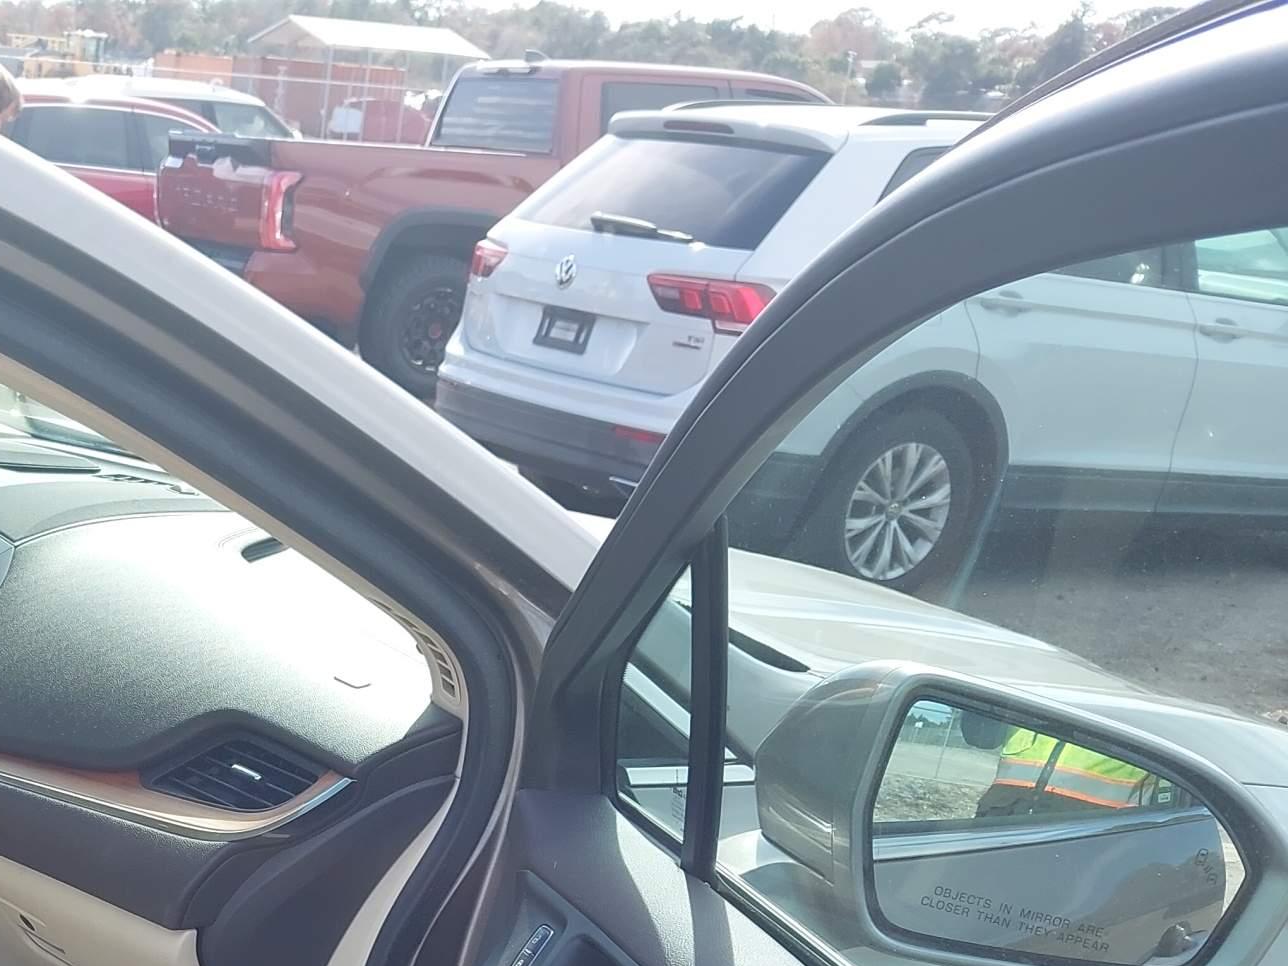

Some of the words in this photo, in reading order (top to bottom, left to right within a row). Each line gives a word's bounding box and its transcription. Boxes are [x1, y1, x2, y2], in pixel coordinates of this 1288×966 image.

[920, 895, 970, 917] CLOSER
[976, 910, 1012, 929] THAN
[1018, 921, 1056, 937] THEY
[1056, 932, 1110, 952] APPEAR
[934, 886, 992, 909] OBJECTS
[999, 902, 1012, 915] IN
[1019, 908, 1071, 929] MIRROR
[1077, 923, 1105, 938] ARE
